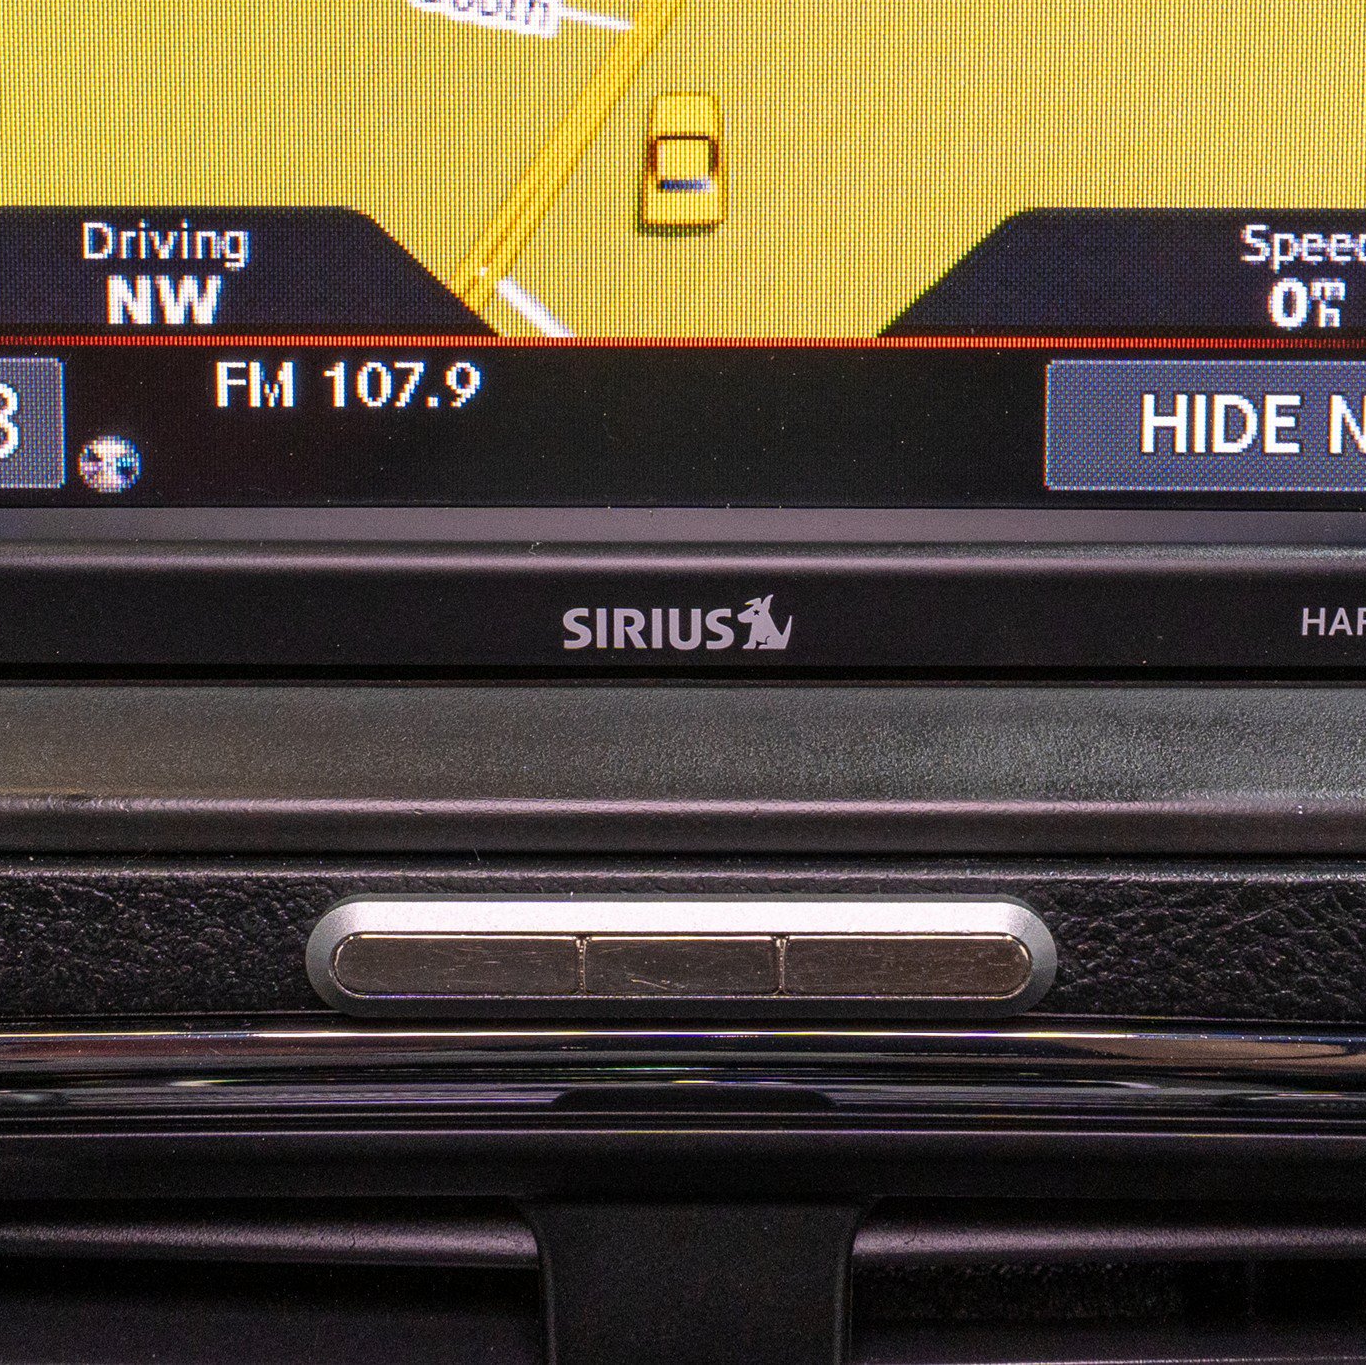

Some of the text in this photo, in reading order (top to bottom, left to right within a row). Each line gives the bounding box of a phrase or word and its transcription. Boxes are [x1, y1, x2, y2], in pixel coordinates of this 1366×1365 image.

[82, 218, 250, 269] Driving
[107, 274, 221, 325] NW
[215, 362, 482, 409] FM 107.9
[1141, 393, 1302, 454] HIDE
[562, 607, 733, 650] SIRIUS
